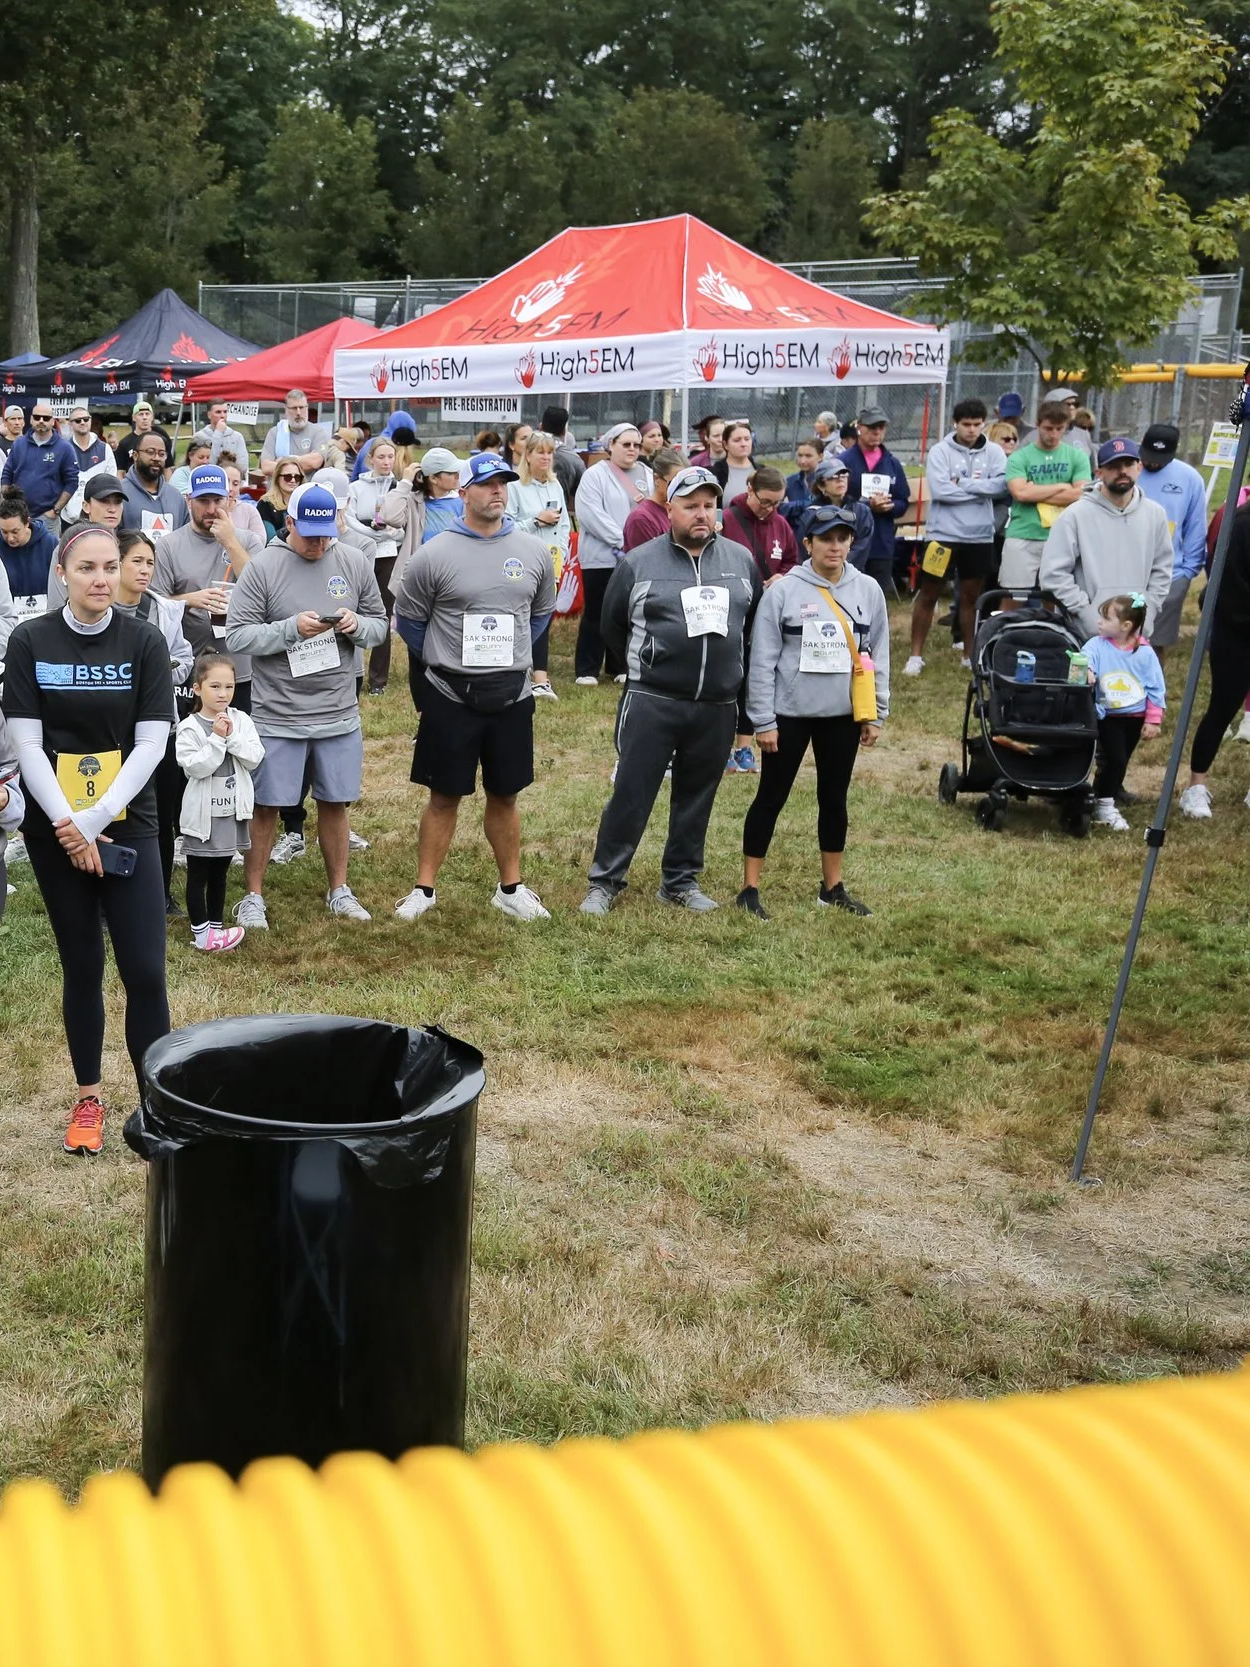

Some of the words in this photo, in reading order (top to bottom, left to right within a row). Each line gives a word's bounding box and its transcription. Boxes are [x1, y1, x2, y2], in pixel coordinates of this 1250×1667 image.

[456, 307, 631, 345] High5EM
[540, 346, 635, 382] High5EM
[722, 343, 820, 376] High5EM
[855, 343, 945, 374] High5EM
[391, 356, 468, 388] High5EM
[444, 397, 518, 412] PRE-REGISTRATION
[1030, 463, 1069, 474] SALVE
[685, 605, 700, 615] SAK
[702, 604, 728, 615] STRONG
[287, 645, 304, 655] SAK
[303, 636, 336, 650] STRONG
[75, 663, 133, 680] BSSC
[174, 686, 195, 698] RAD
[86, 780, 95, 797] 8
[211, 797, 231, 807] FUN
